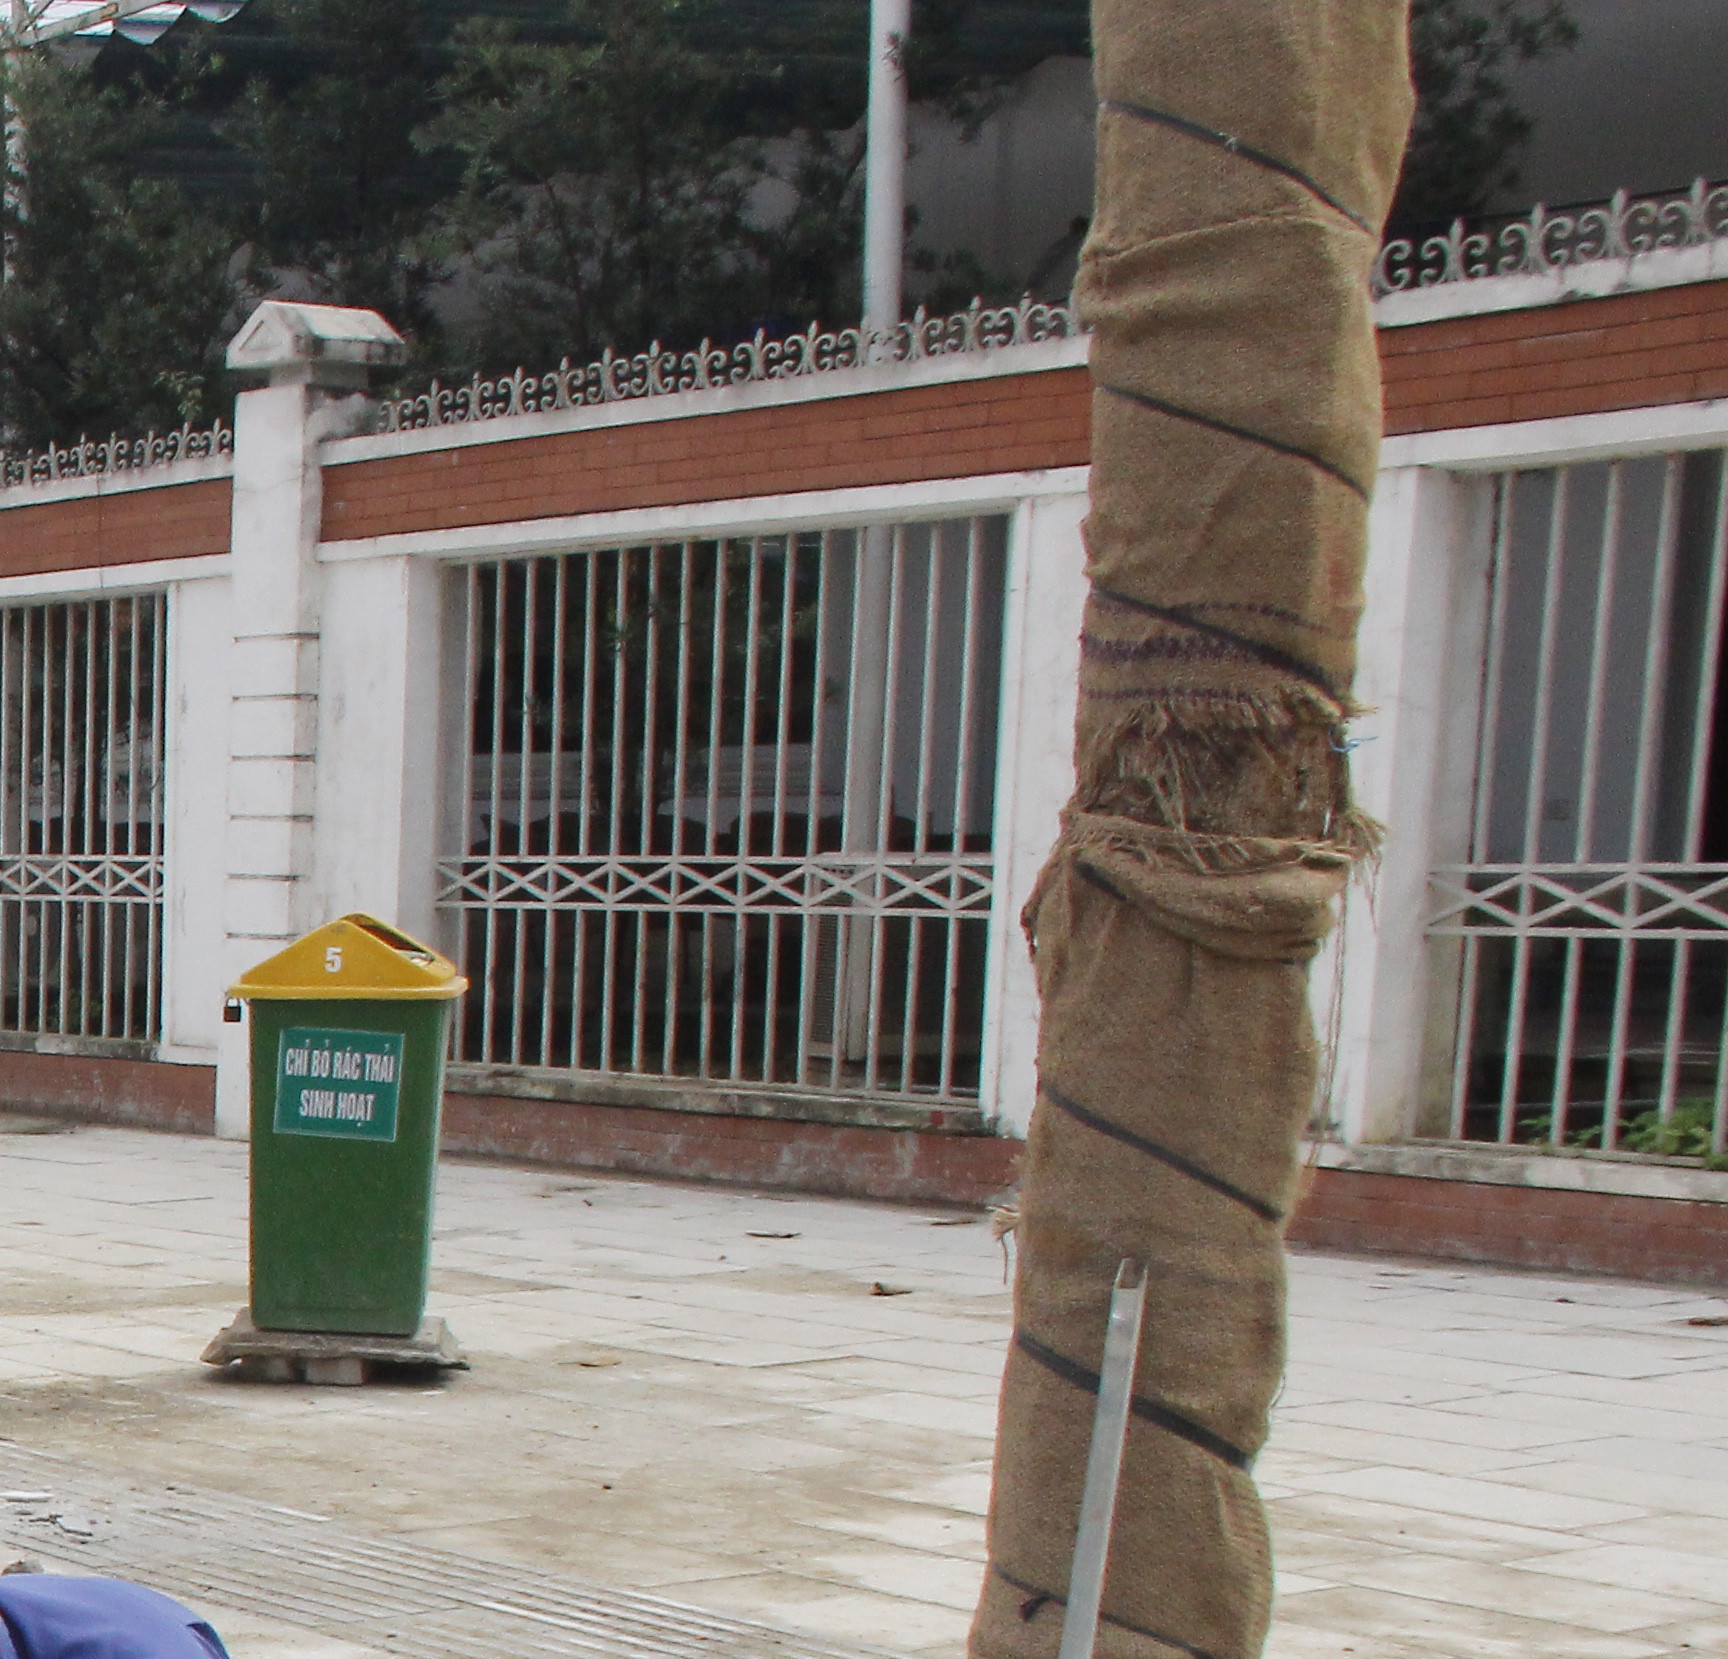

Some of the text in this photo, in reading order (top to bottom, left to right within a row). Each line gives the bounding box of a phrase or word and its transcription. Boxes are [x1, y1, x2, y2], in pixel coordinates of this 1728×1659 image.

[324, 947, 343, 973] 5
[285, 1038, 395, 1083] CHỈ BỎ RÁC THẢI
[299, 1089, 377, 1128] SINH HOẠT
